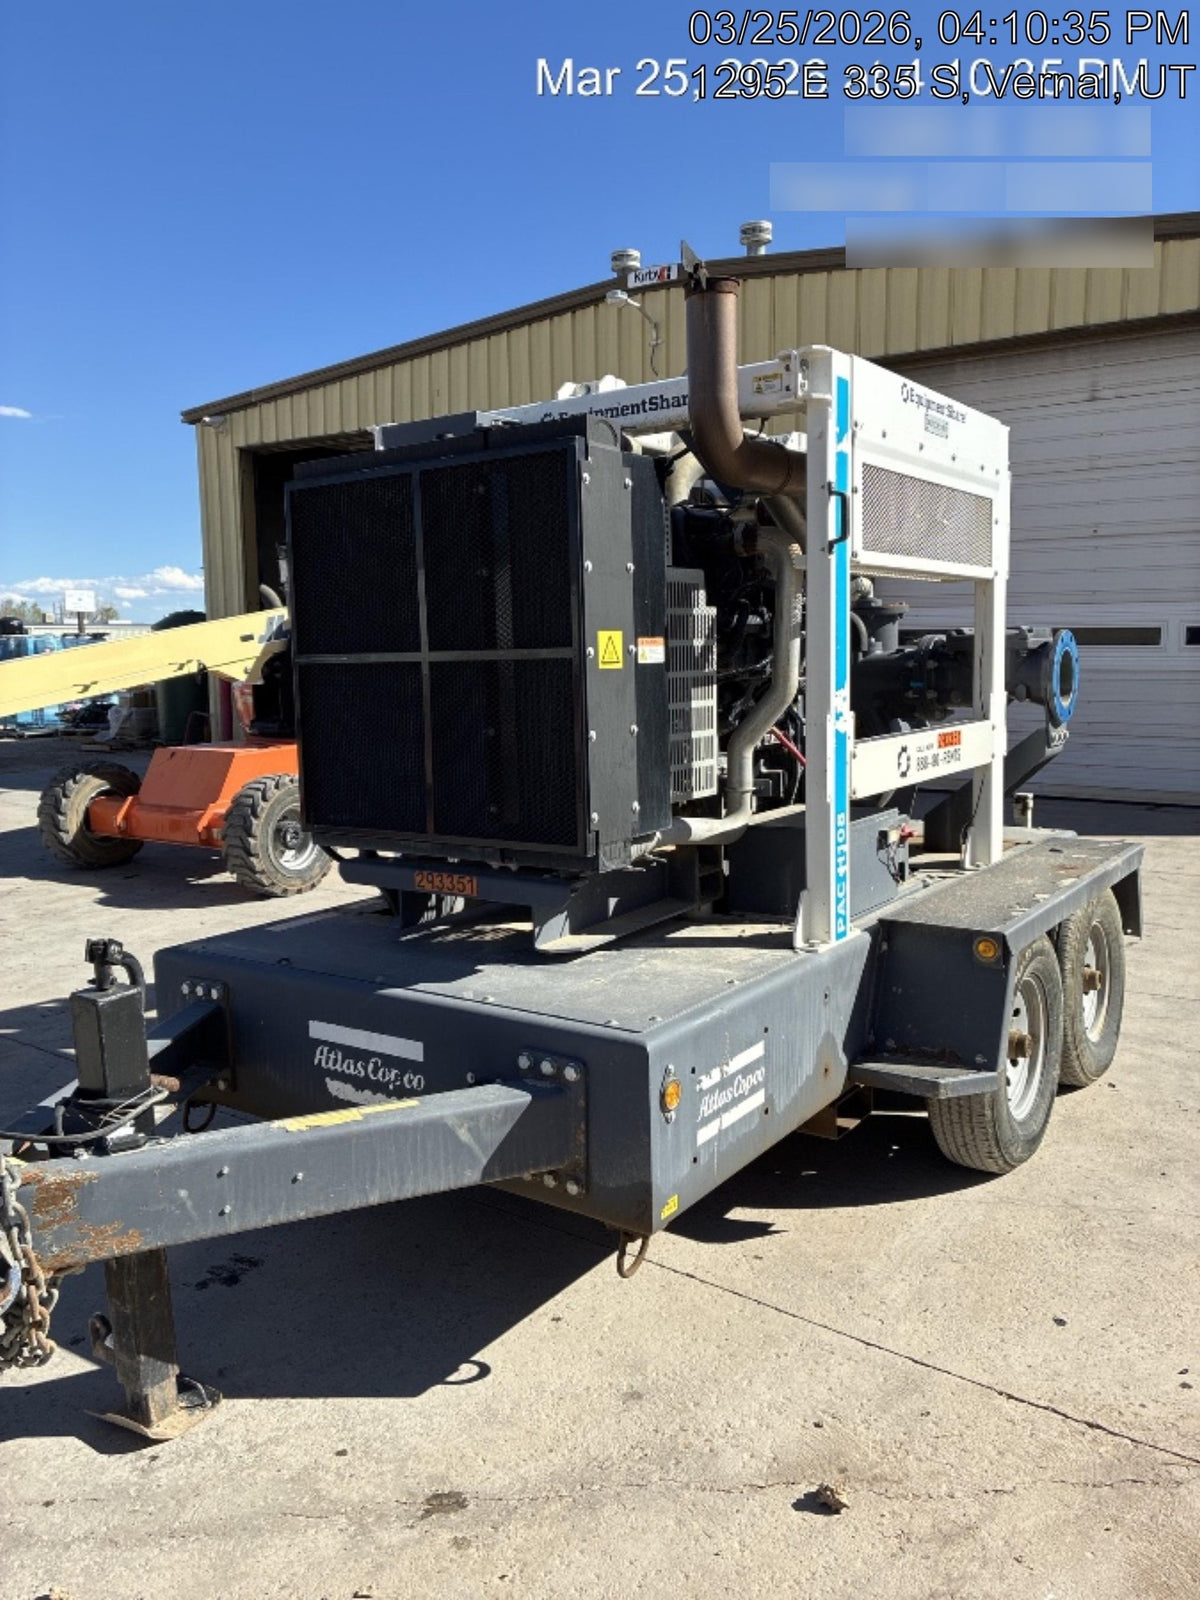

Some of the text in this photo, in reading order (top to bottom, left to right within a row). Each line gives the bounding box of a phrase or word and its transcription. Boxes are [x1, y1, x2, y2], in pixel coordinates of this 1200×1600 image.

[415, 871, 475, 895] 293351
[836, 881, 846, 934] PAC
[314, 1044, 365, 1078] Atlas
[697, 1066, 766, 1123] Atlas Copco
